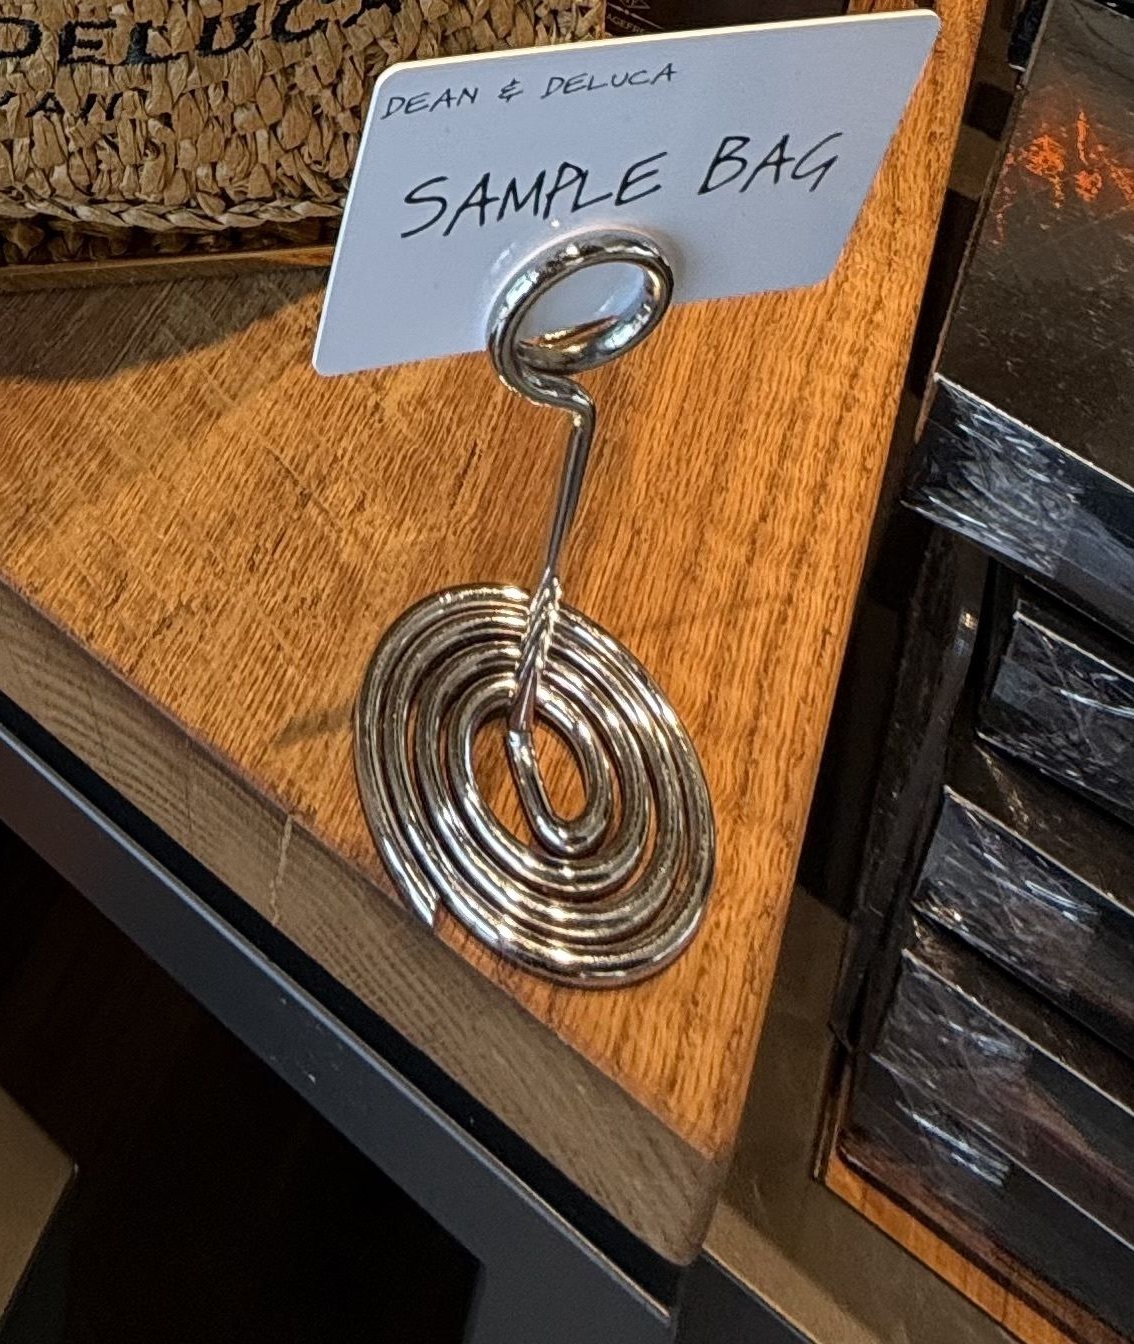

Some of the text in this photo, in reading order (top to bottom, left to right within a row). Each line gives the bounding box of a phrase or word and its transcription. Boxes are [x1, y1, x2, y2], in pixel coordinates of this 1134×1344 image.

[381, 62, 678, 120] DEAN & DELUCA
[400, 131, 845, 239] SAMPLE BAG
